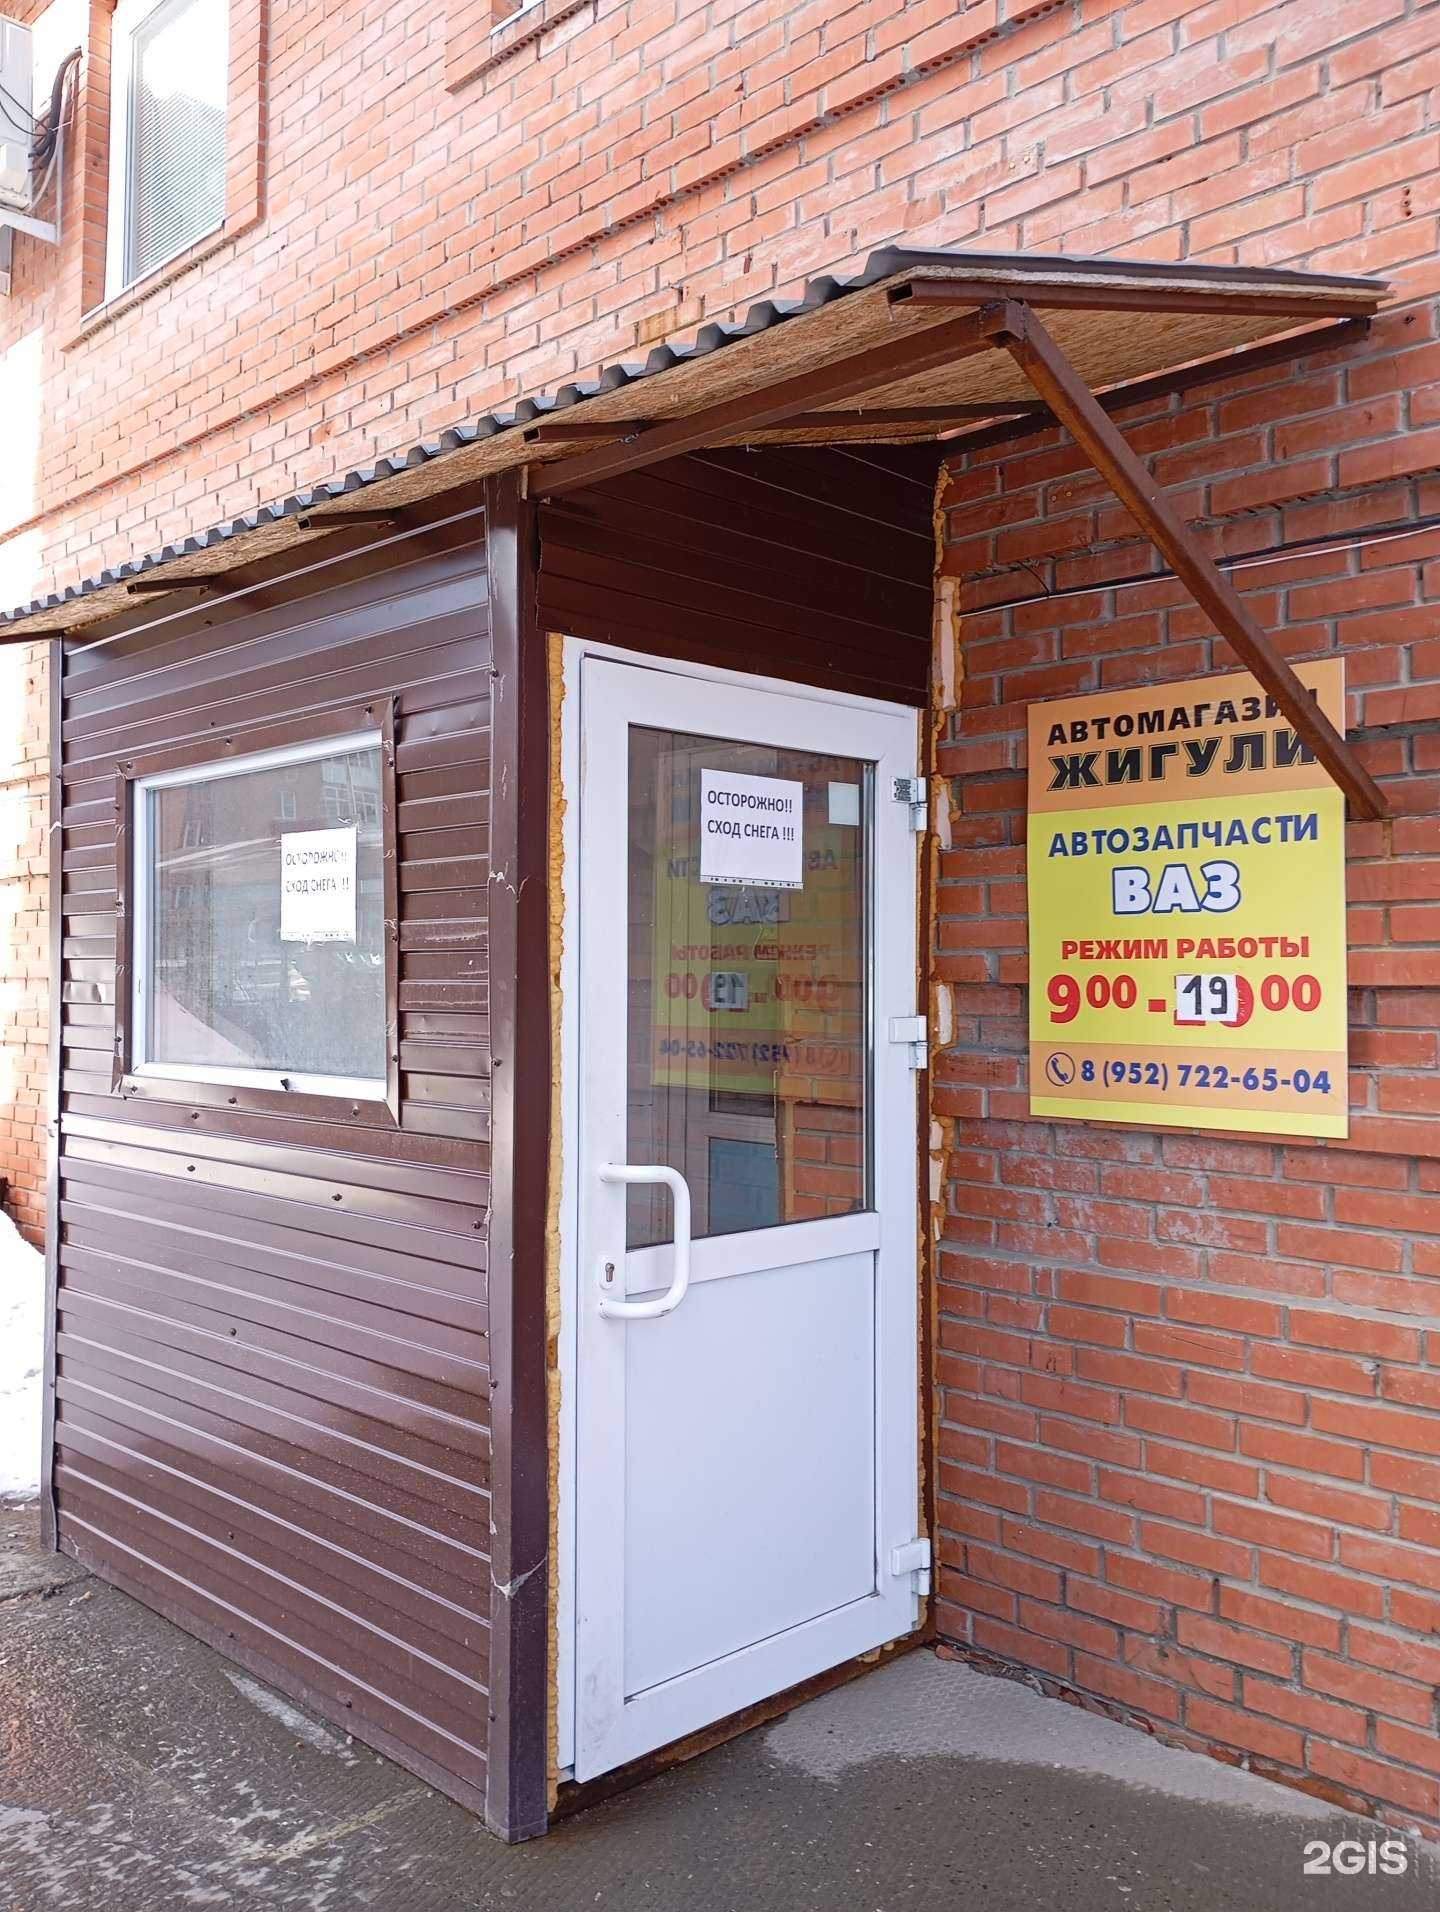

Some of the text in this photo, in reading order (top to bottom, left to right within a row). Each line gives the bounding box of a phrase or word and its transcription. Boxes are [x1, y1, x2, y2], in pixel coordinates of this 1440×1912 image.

[1047, 688, 1318, 746] АВТОМАГАЗИ
[1047, 728, 1320, 791] ЖИГУЛИ
[707, 790, 793, 813] ОСТОРОЖНО!!
[707, 820, 742, 839] СХОД
[744, 824, 780, 839] СНЕГА
[1048, 813, 1319, 857] АВТОЗАПЧАСТИ
[1112, 860, 1241, 914] ВАЗ
[1061, 936, 1310, 960] РЕЖИМ РАБОТЫ
[1080, 1060, 1331, 1094] 8 (952) 722-65-04
